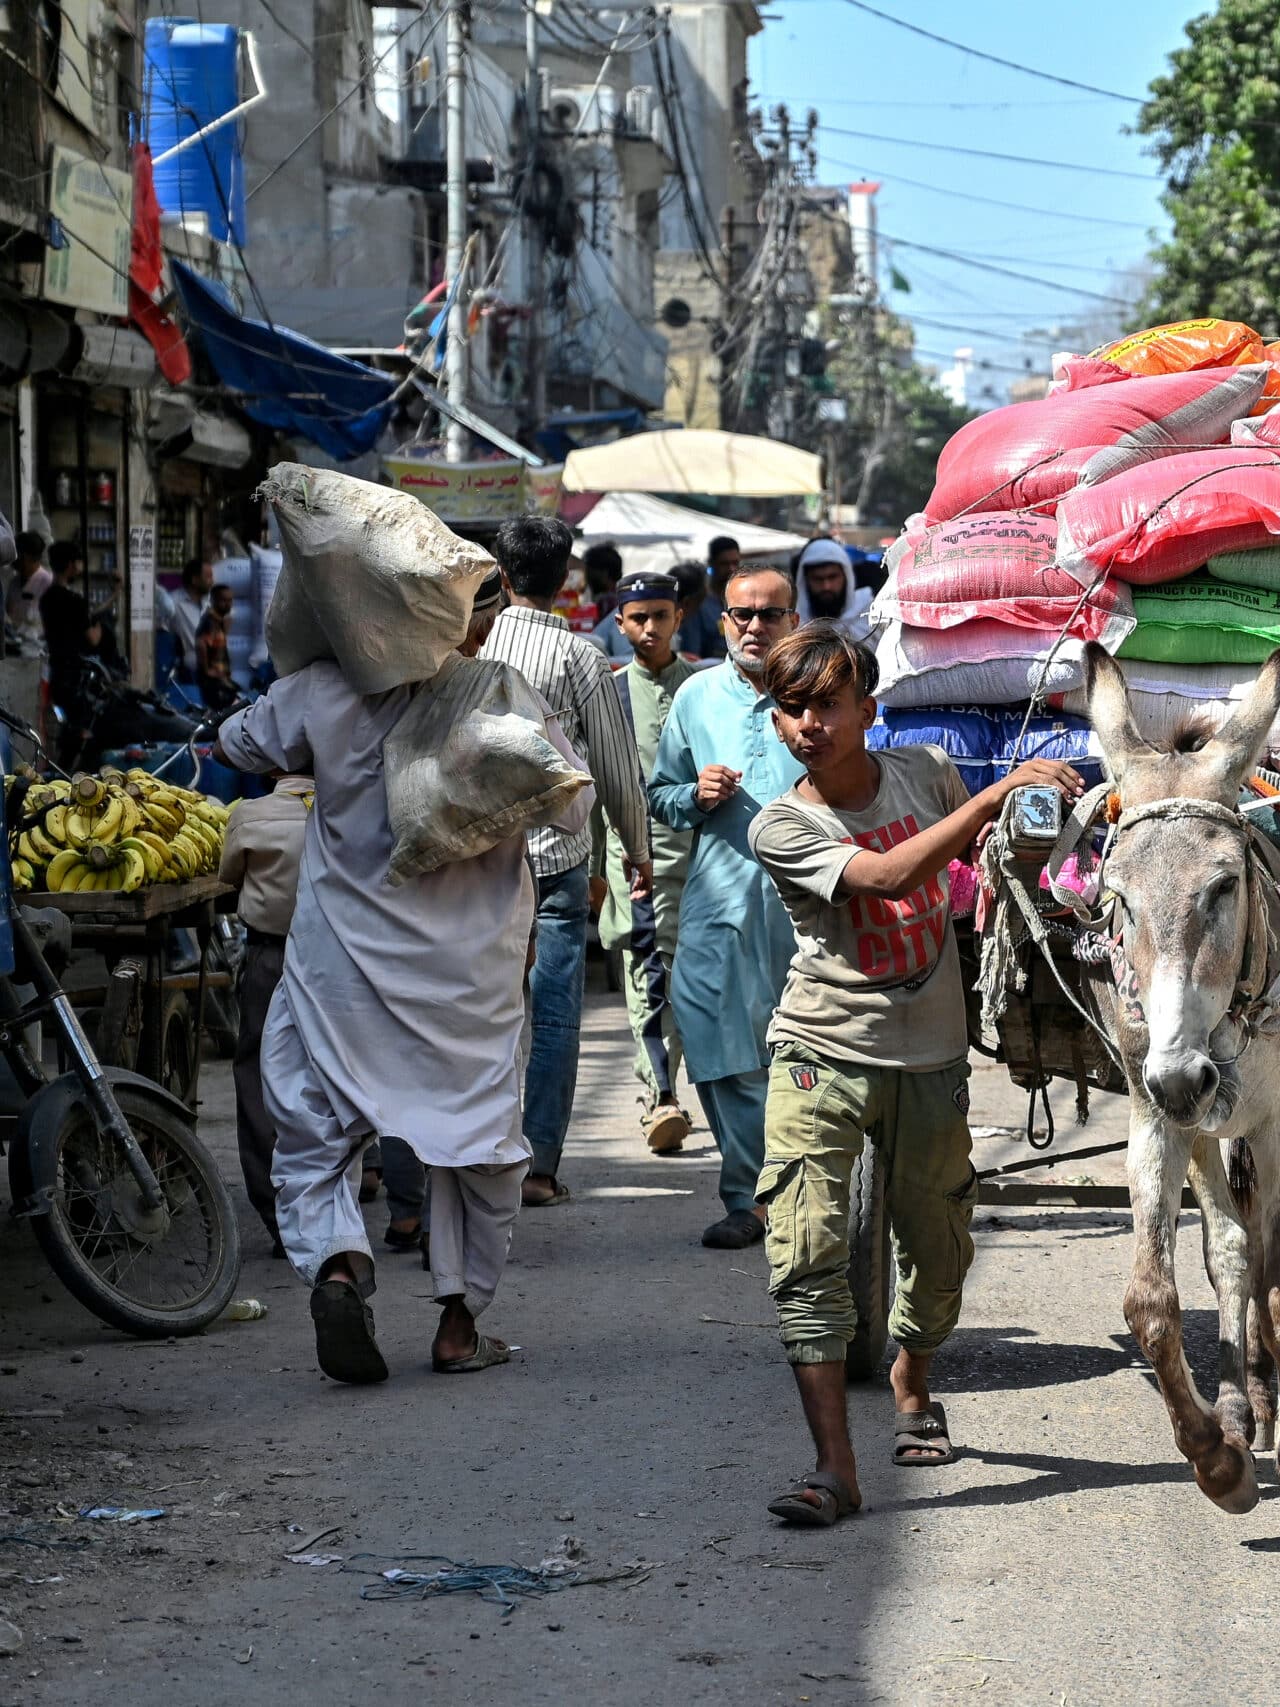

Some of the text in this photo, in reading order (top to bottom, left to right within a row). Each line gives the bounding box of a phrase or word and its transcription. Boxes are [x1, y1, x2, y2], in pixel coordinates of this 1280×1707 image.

[1189, 587, 1205, 596] OF
[1207, 587, 1261, 606] PAKISTAN
[839, 814, 921, 854] EW
[857, 908, 944, 978] CITY
